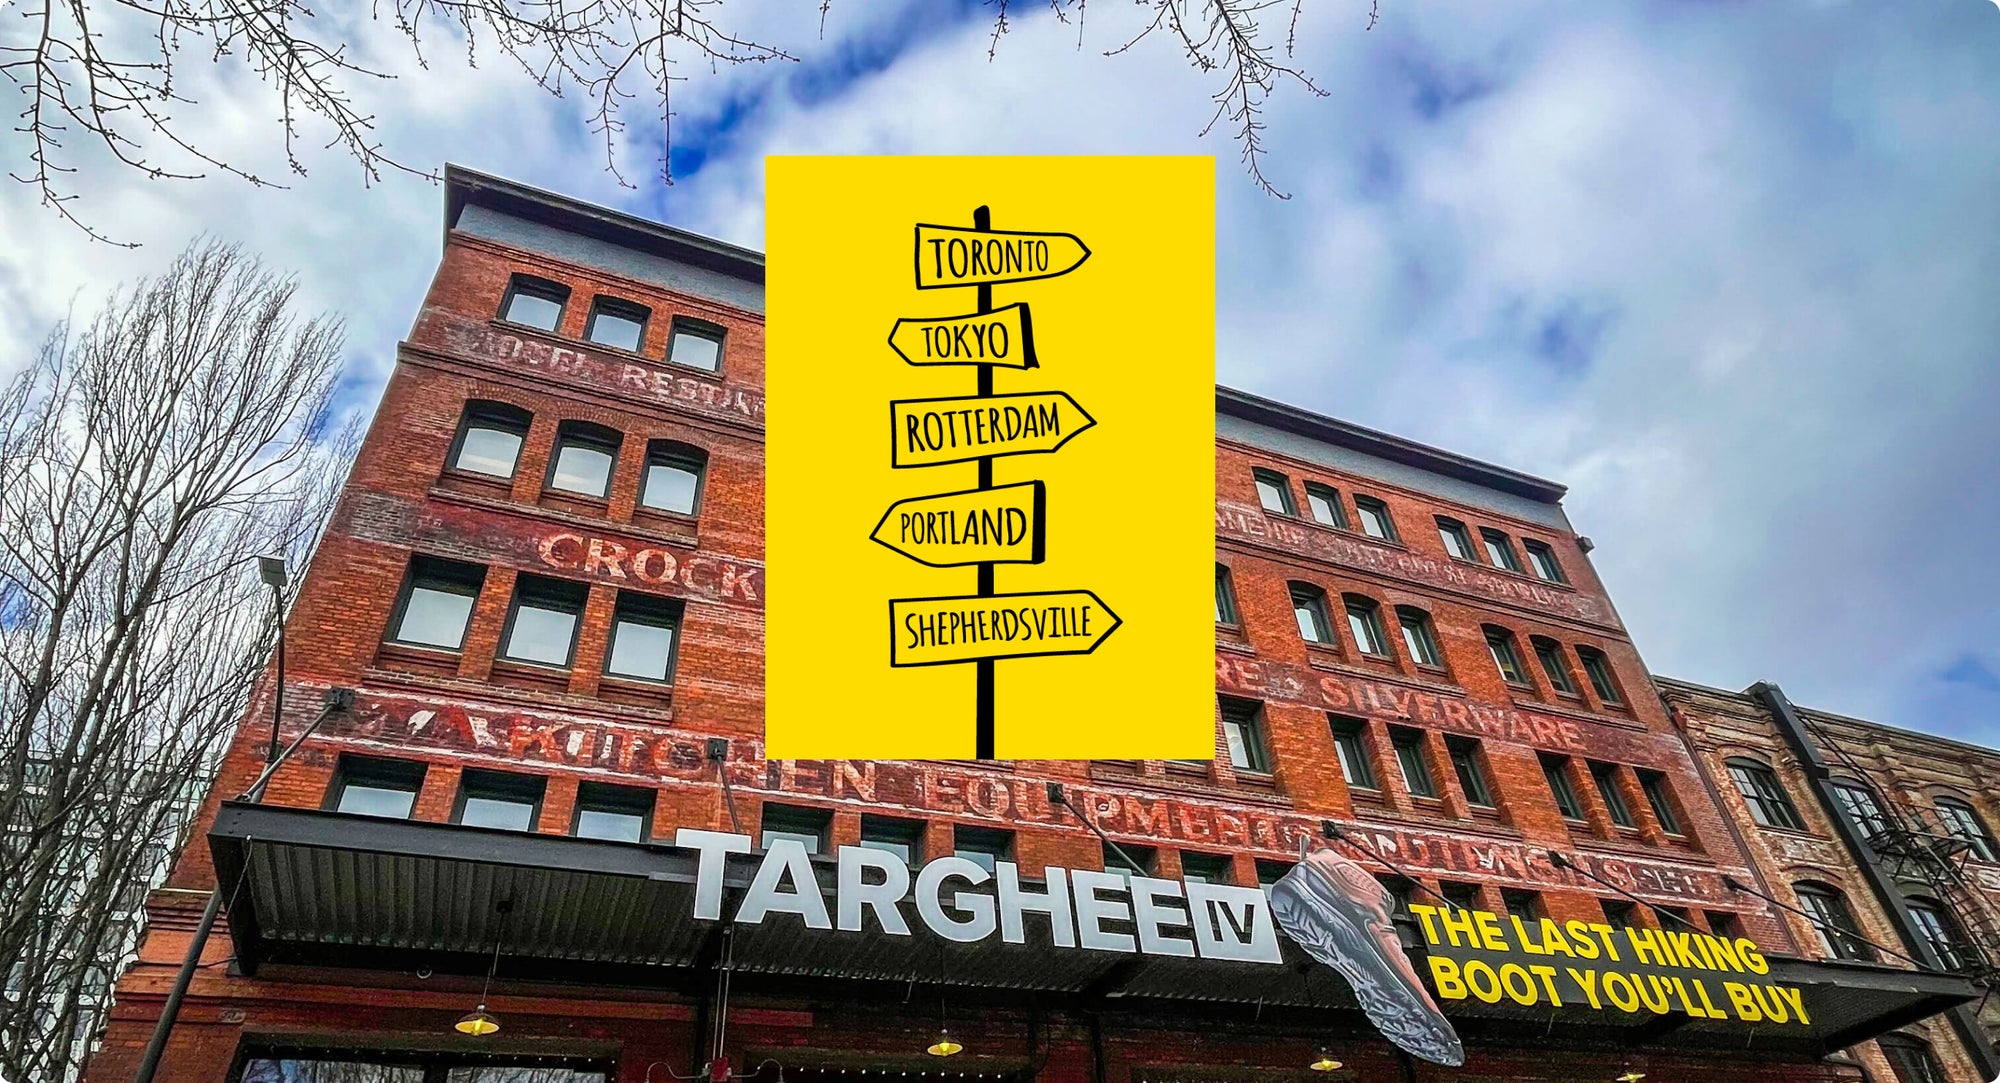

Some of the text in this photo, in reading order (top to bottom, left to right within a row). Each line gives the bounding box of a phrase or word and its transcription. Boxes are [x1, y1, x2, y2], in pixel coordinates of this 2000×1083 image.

[538, 533, 758, 601] CROCK
[1319, 675, 1590, 751] SILVERWARE
[675, 828, 1195, 958] TARGHEE
[1205, 900, 1269, 945] IV
[1409, 903, 1770, 976] THE LAST HIKING
[1427, 955, 1563, 1008] BOOT
[1722, 981, 1811, 1026] BUY
